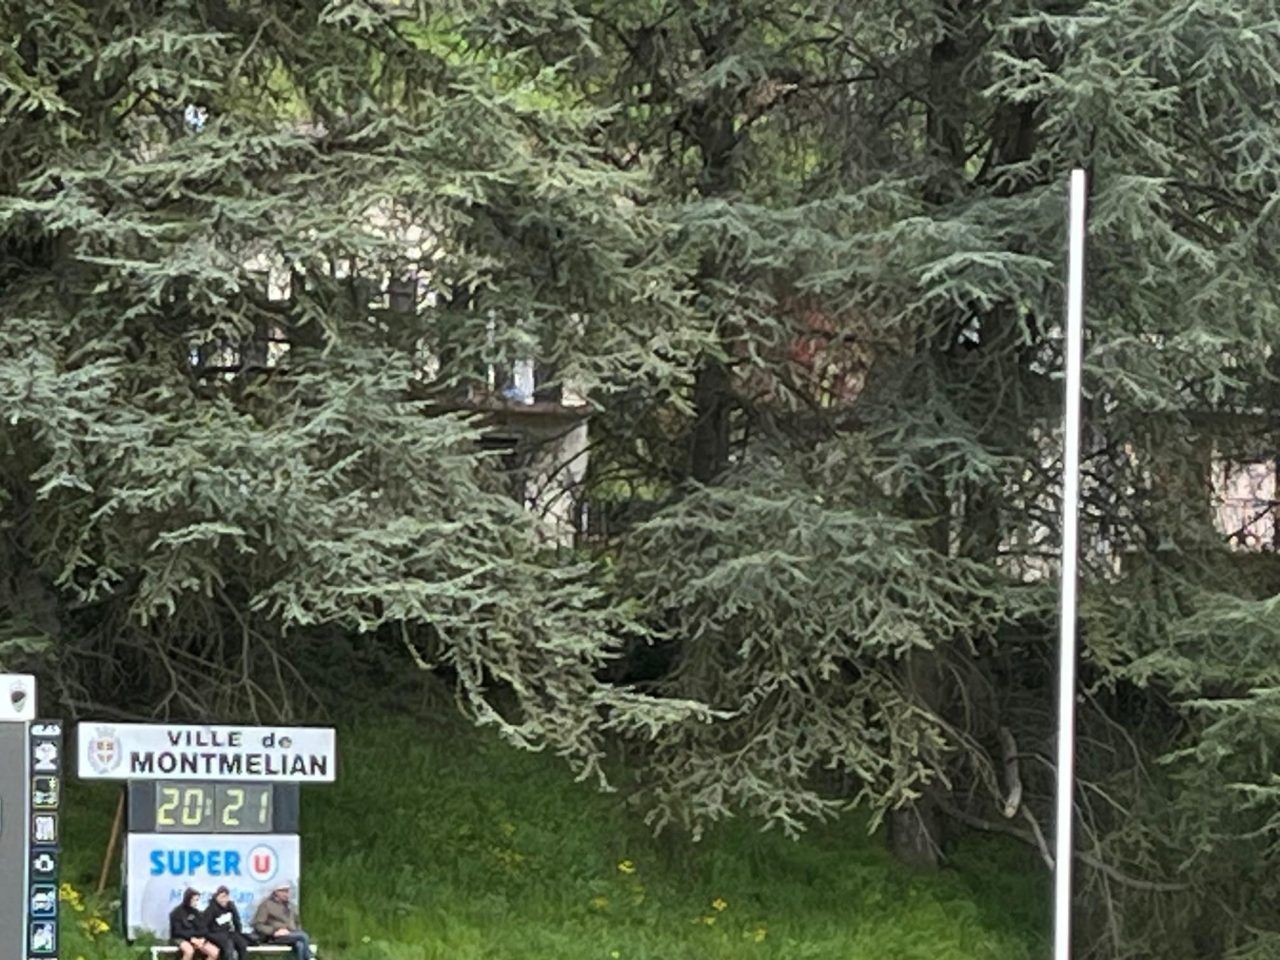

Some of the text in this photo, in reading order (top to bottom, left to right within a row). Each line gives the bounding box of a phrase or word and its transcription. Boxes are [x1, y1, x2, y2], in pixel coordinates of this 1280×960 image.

[167, 730, 294, 749] VILLE de
[130, 751, 328, 776] MONTMELIAN
[149, 849, 271, 876] SUPER U
